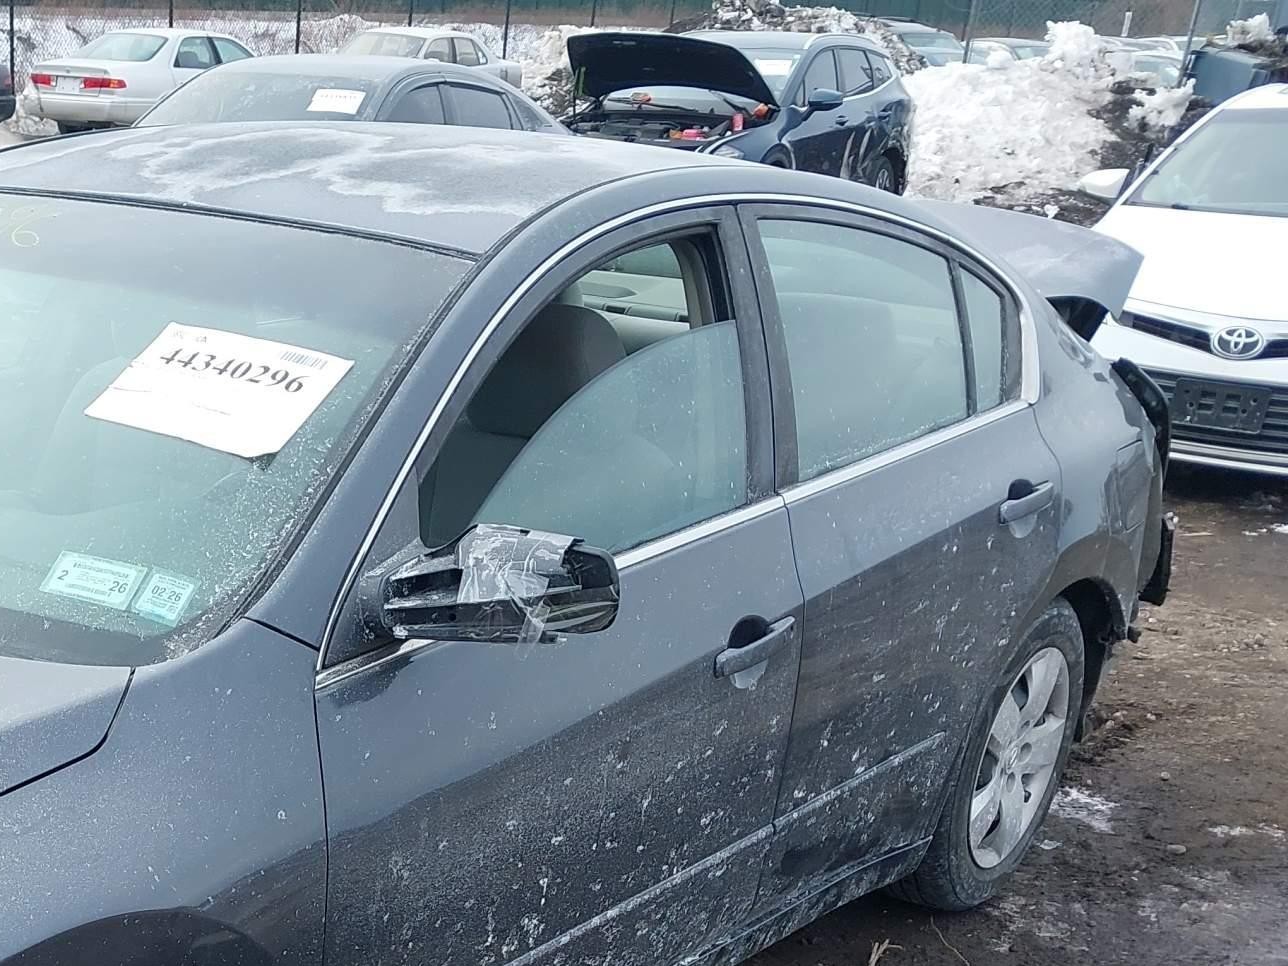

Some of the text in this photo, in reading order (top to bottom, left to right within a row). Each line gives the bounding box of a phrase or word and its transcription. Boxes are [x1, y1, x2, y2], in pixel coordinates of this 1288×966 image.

[159, 348, 311, 393] 44340296
[57, 569, 69, 581] 2
[108, 580, 129, 594] 26
